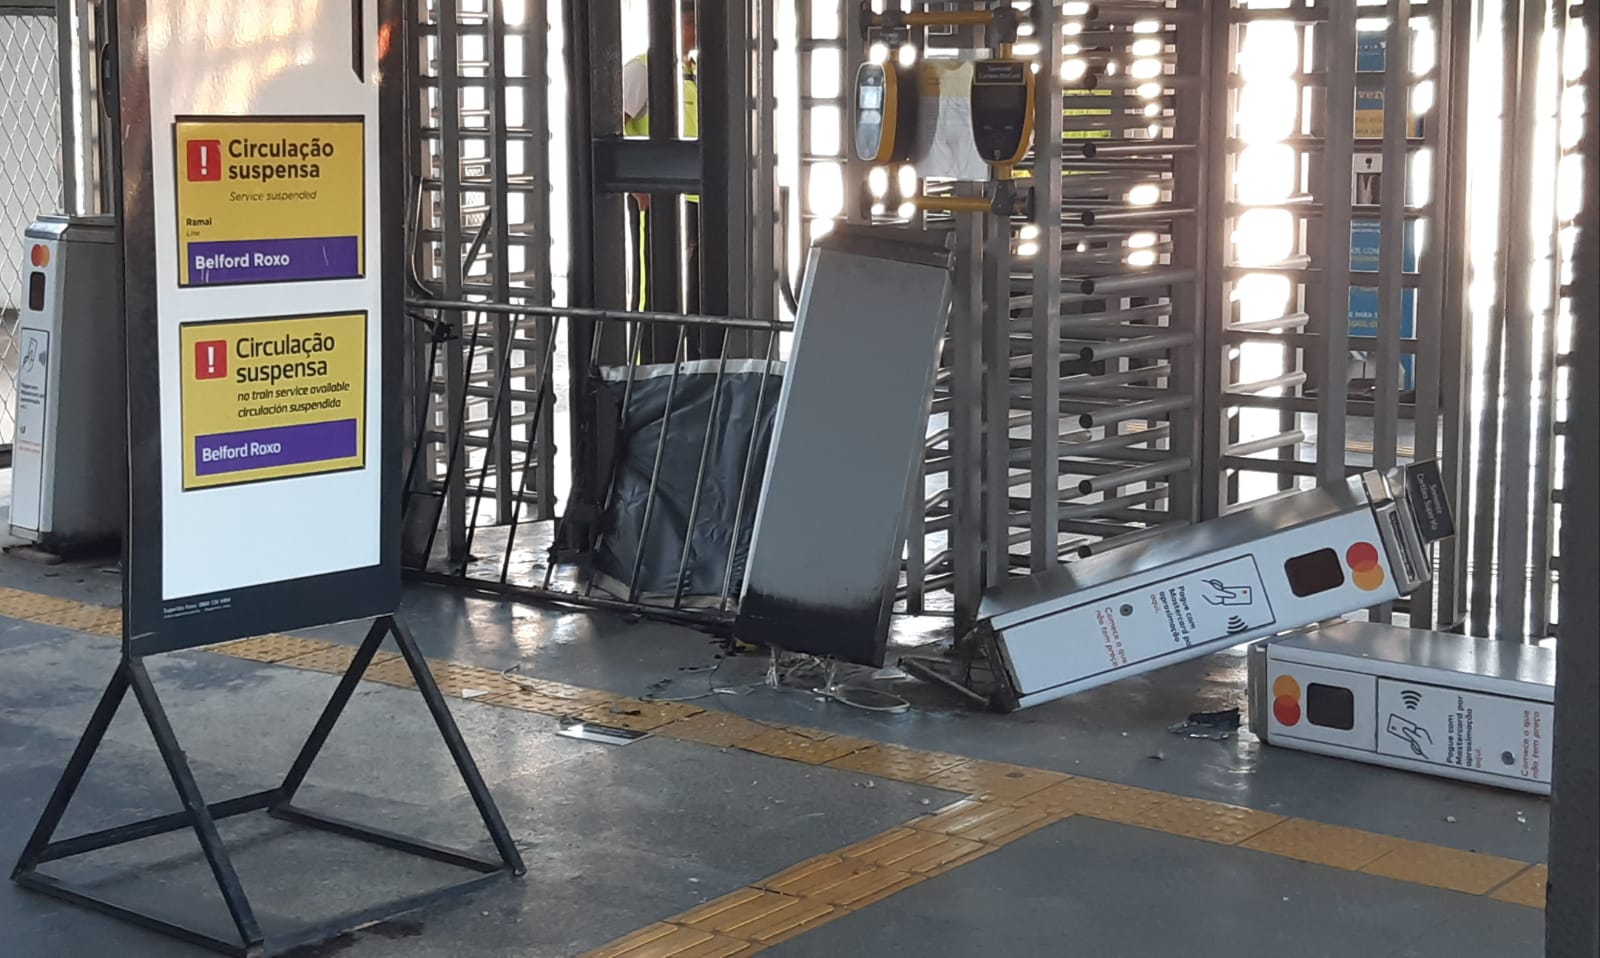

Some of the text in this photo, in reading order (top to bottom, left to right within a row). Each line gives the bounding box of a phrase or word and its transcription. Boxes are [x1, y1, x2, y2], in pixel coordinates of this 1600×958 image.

[228, 138, 334, 160] Circulação
[228, 164, 320, 183] suspensa
[229, 190, 318, 201] Service suspended
[186, 217, 213, 227] Ramal
[195, 252, 290, 270] Belford Roxo
[236, 332, 335, 359] Circulação
[236, 360, 328, 386] suspensa
[237, 381, 350, 402] no train service available
[238, 398, 341, 418] circulación suspendida
[202, 442, 282, 462] Belford Roxo
[1160, 591, 1179, 642] aproximação
[1168, 589, 1192, 649] Mastercard po
[1178, 586, 1196, 629] Pague com
[1105, 607, 1119, 640] Comece
[1118, 649, 1127, 663] que
[1523, 710, 1531, 728] que
[1446, 735, 1455, 764] Pague
[1455, 713, 1463, 765] Mastercard
[1464, 708, 1472, 767] aproximação
[1521, 739, 1529, 777] Comece
